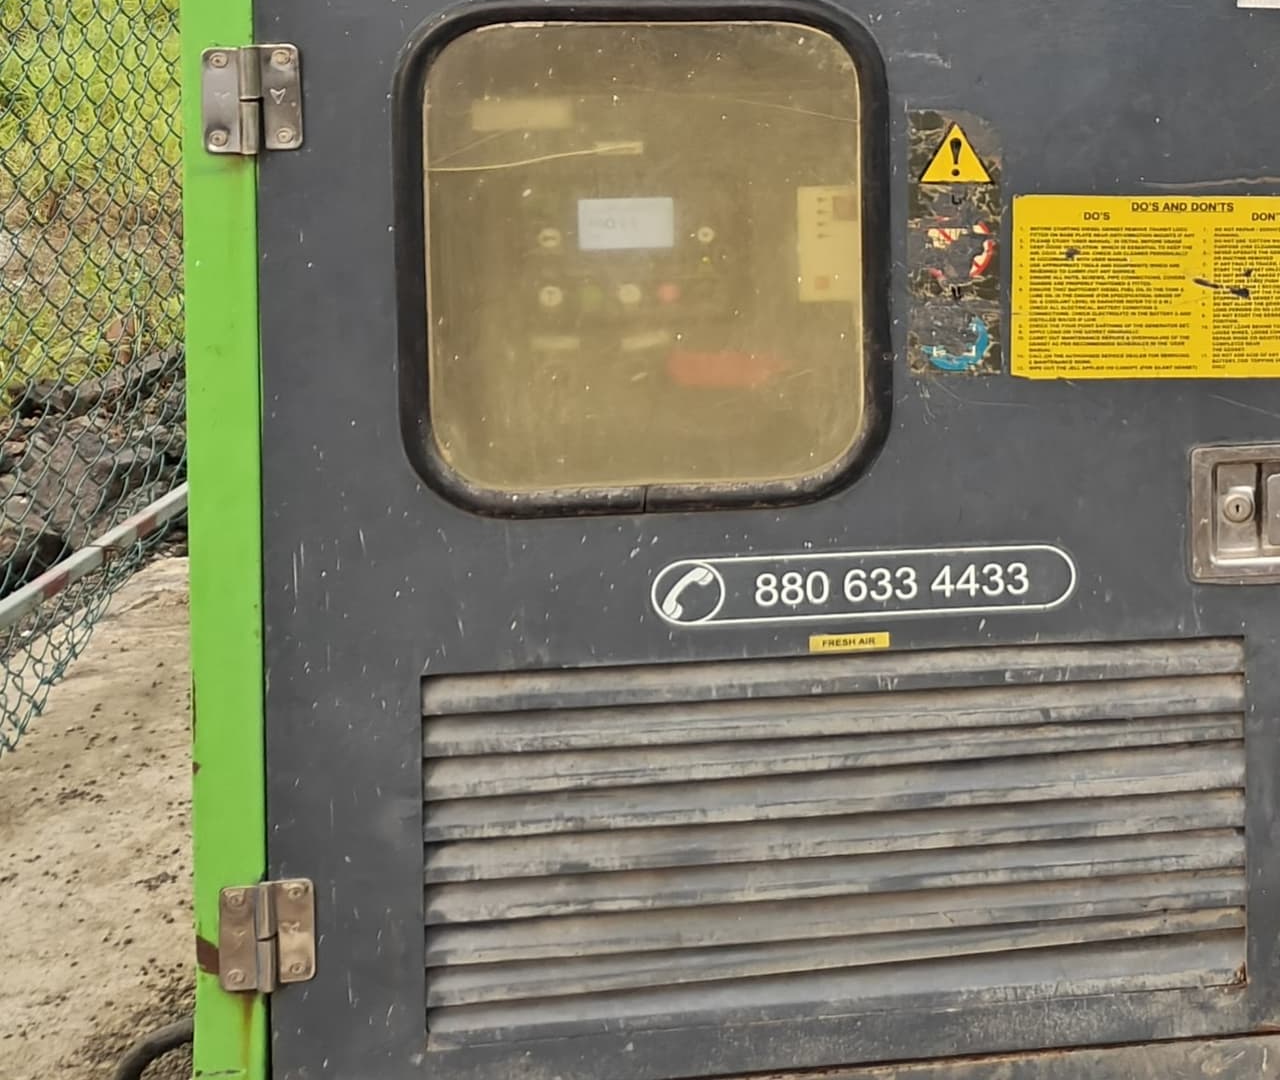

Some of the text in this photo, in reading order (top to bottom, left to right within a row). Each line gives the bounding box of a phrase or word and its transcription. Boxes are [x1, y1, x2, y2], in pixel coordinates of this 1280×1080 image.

[1131, 202, 1234, 212] DO'S AND DON'TS
[1083, 211, 1110, 221] DO'S
[754, 562, 1030, 607] 880 633 4433
[822, 637, 876, 647] FRESH AIR
